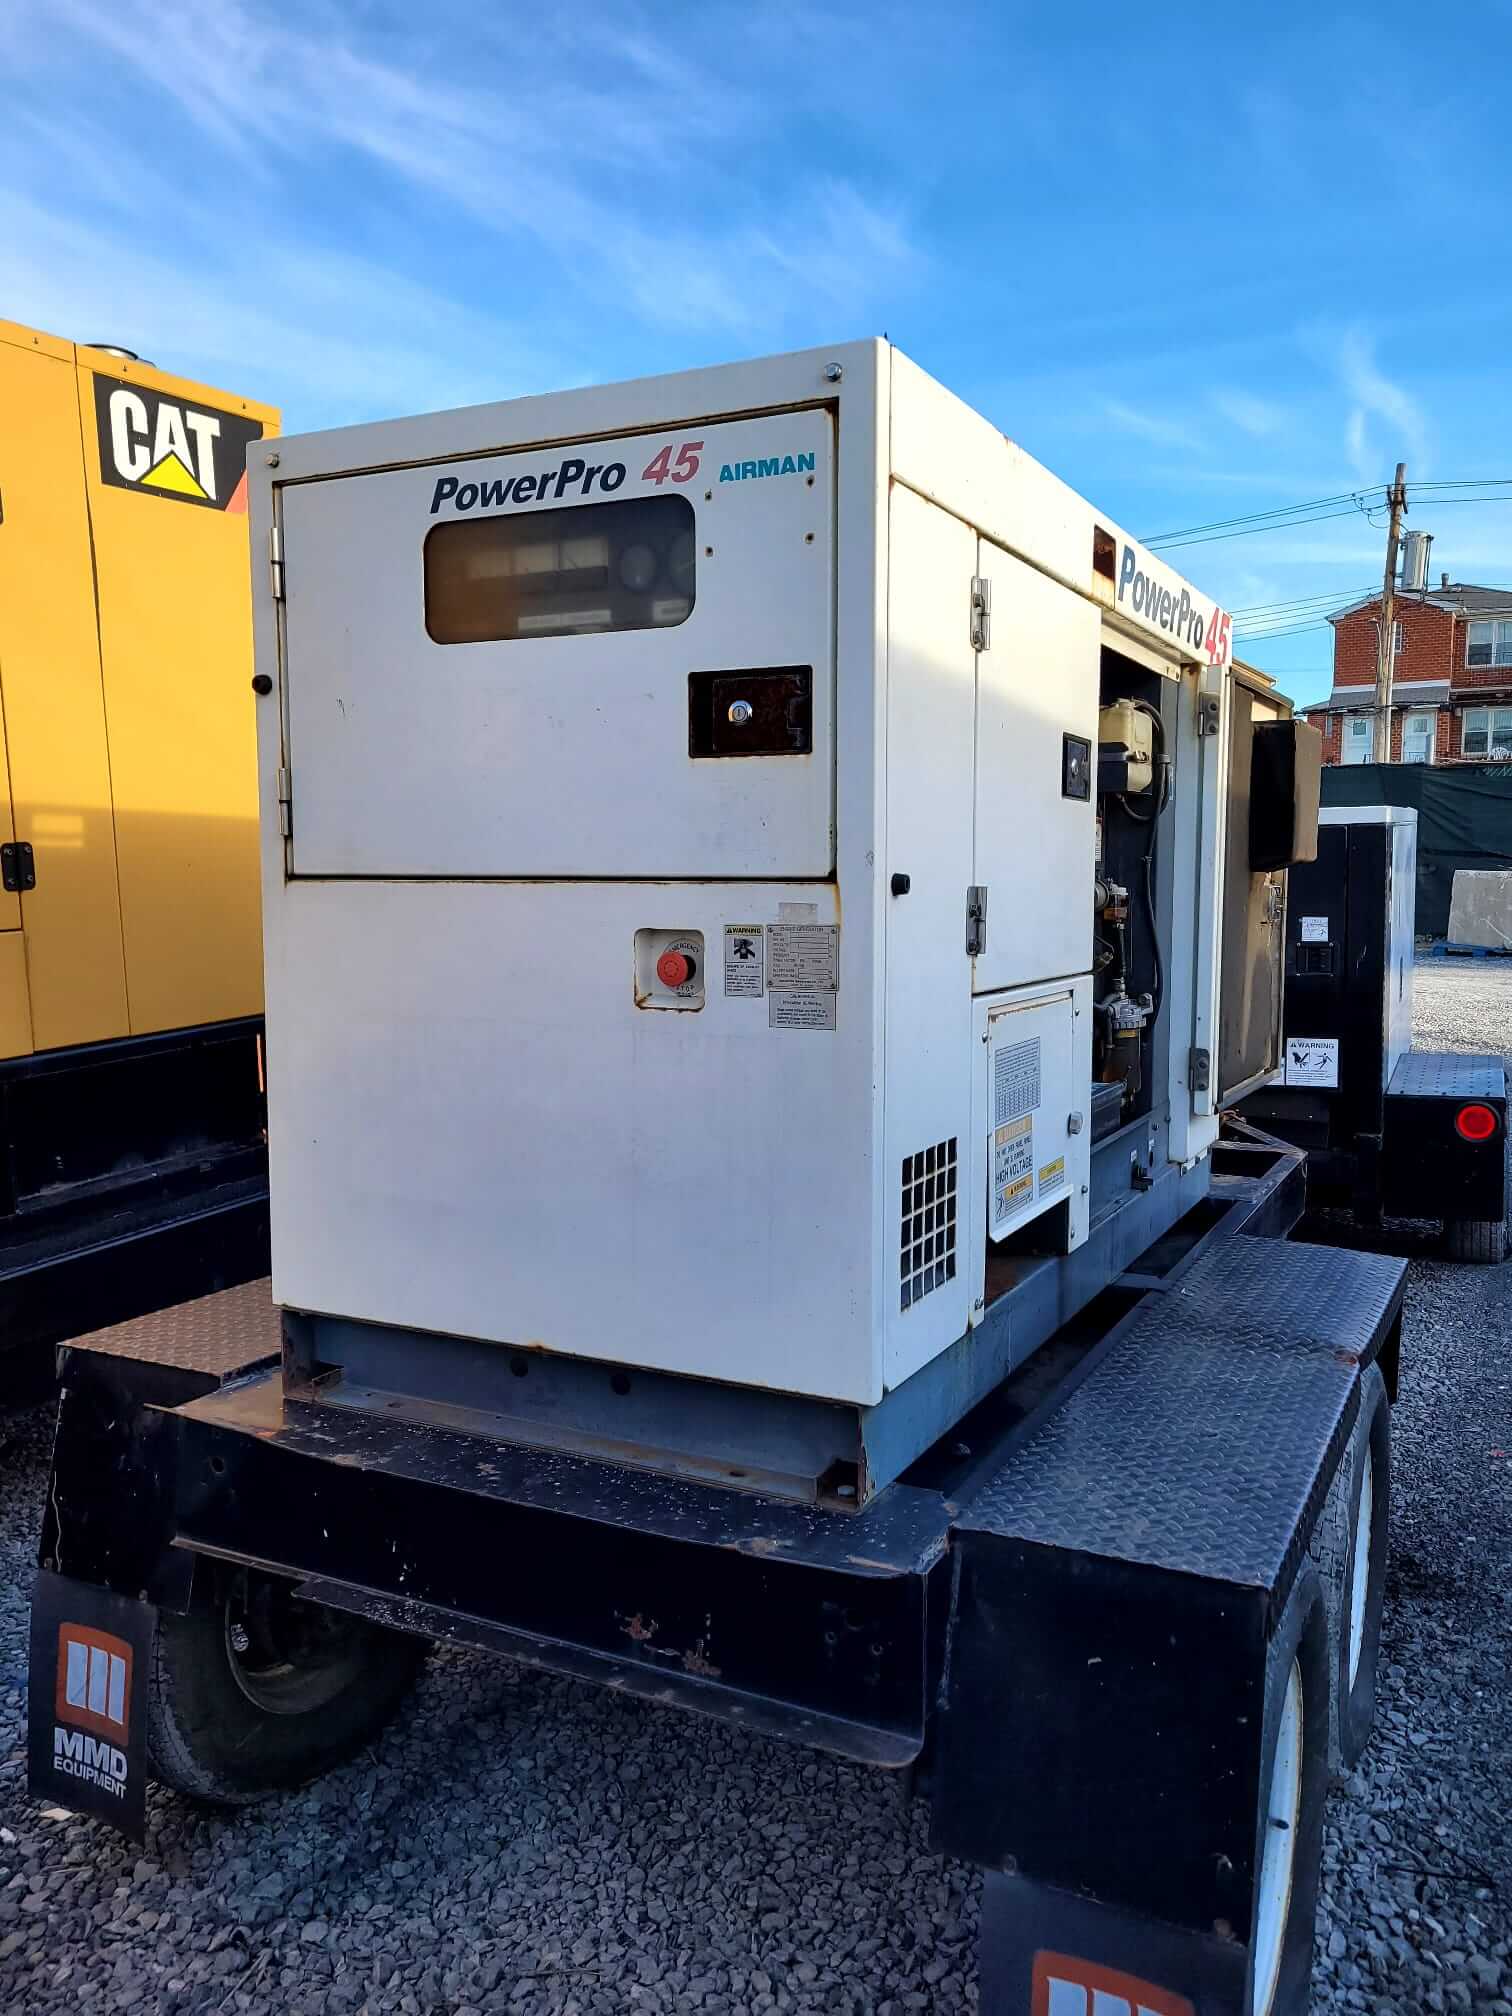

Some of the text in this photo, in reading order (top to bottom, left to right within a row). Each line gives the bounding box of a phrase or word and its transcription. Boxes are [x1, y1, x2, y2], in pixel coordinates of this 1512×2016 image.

[109, 390, 221, 501] CAT
[430, 441, 705, 514] PowerPro 45
[719, 452, 815, 482] AIRMAN
[1118, 546, 1231, 665] PowerPro 45
[53, 1756, 127, 1799] EQUIPMENT
[54, 1727, 128, 1783] MMD
